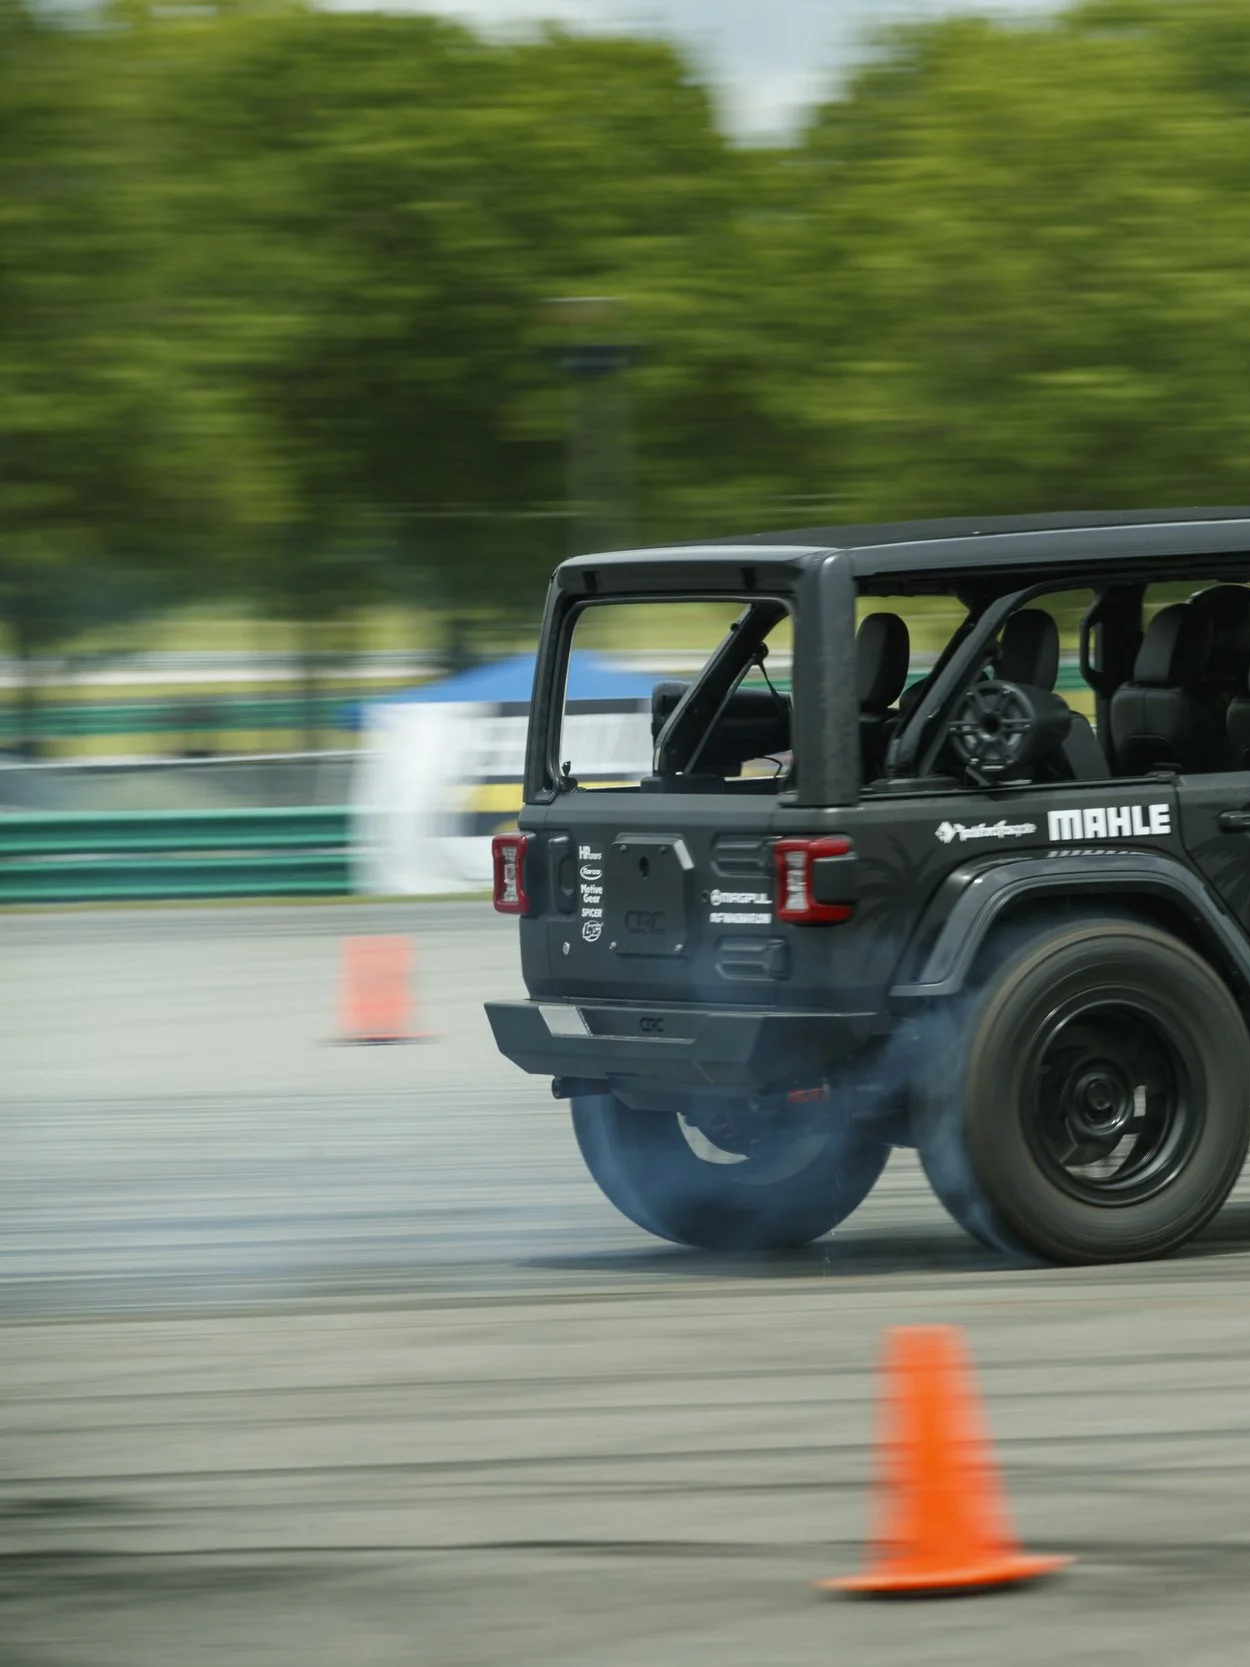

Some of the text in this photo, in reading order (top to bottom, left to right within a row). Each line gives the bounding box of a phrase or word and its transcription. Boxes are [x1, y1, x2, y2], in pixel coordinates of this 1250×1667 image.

[1047, 803, 1171, 841] MAHLE
[580, 884, 603, 895] Motive
[583, 893, 601, 904] Gear
[581, 907, 603, 918] SPICER
